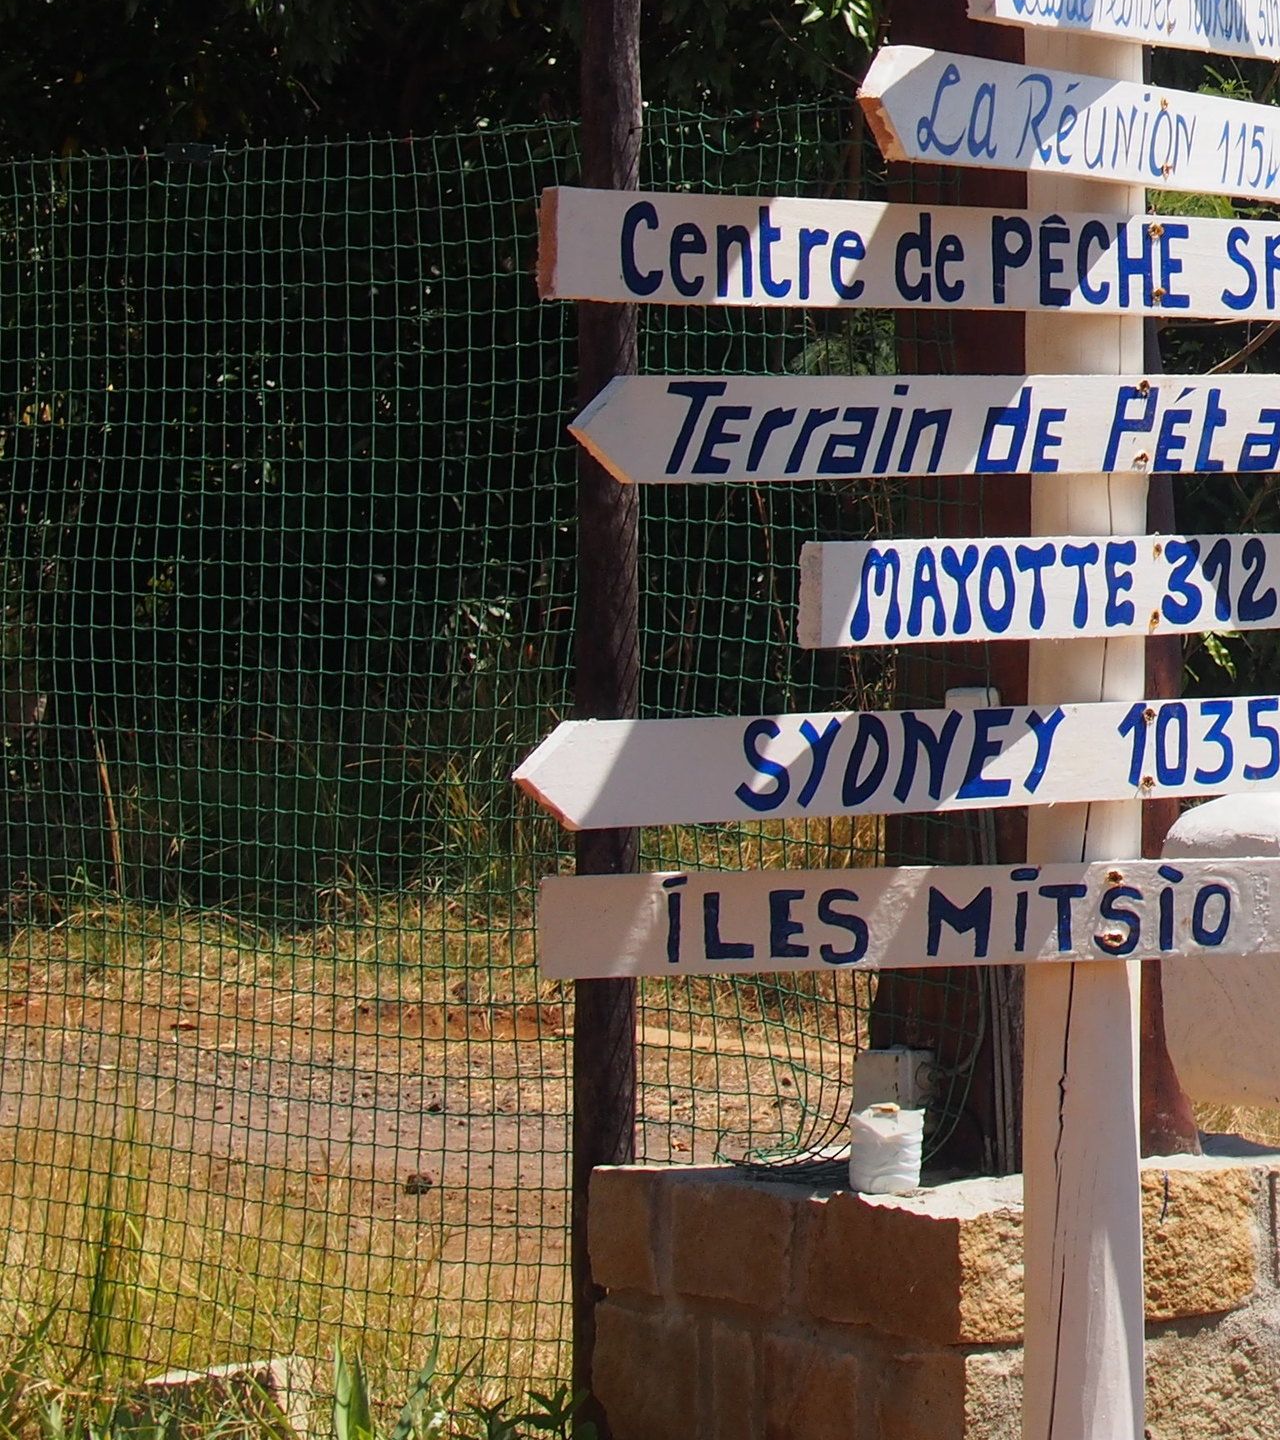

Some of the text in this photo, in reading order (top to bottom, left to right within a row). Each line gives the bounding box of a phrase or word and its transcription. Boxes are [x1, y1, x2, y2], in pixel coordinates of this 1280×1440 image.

[917, 63, 997, 159] La
[620, 201, 866, 300] Centre
[895, 213, 965, 303] de
[992, 214, 1190, 308] PÊCHE
[850, 541, 1136, 642] MAYOTTE
[735, 707, 1066, 812] SYDNEY
